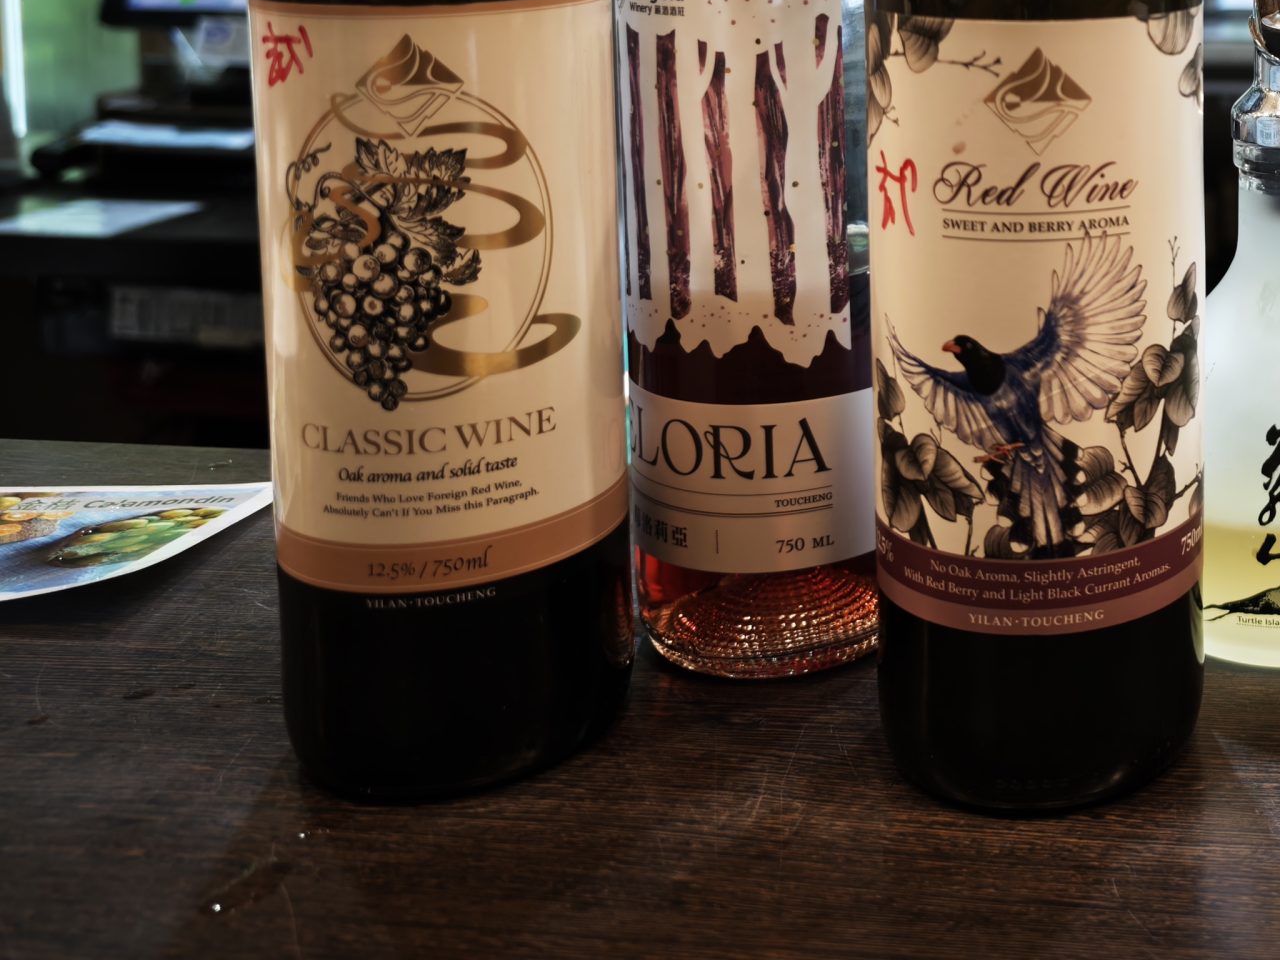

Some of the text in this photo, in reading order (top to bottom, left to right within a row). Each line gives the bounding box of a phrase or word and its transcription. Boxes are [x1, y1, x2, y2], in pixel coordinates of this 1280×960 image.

[629, 1, 652, 16] Winery
[932, 161, 1139, 209] Red Wine
[942, 215, 1130, 233] SWEET AND BERRY AROMA
[301, 406, 558, 455] CLASSIC WINE
[339, 455, 518, 484] Oak aroma and solid taste
[323, 504, 370, 519] Absolutely
[402, 506, 410, 517] If
[412, 505, 433, 516] You
[436, 501, 461, 514] Miss
[464, 498, 484, 511] this
[486, 487, 540, 508] Paragraph.
[336, 491, 369, 504] Friends
[372, 492, 396, 504] Who
[399, 493, 424, 504] Love
[427, 489, 468, 504] Foreign
[471, 484, 491, 496] Red
[774, 491, 833, 508] TOUCHENG
[776, 534, 834, 554] 750 ML
[368, 560, 415, 580] 12.5%
[432, 545, 493, 576] 750ml
[929, 556, 1141, 586] No Oak Aroma, Slightly Astringent,
[904, 566, 924, 584] With
[926, 575, 947, 590] Red
[949, 582, 978, 600] Berry
[982, 585, 1006, 600] and
[1010, 586, 1044, 603] Light
[1048, 585, 1082, 600] Black
[1084, 576, 1131, 595] Currant
[1237, 616, 1263, 626] Turtle
